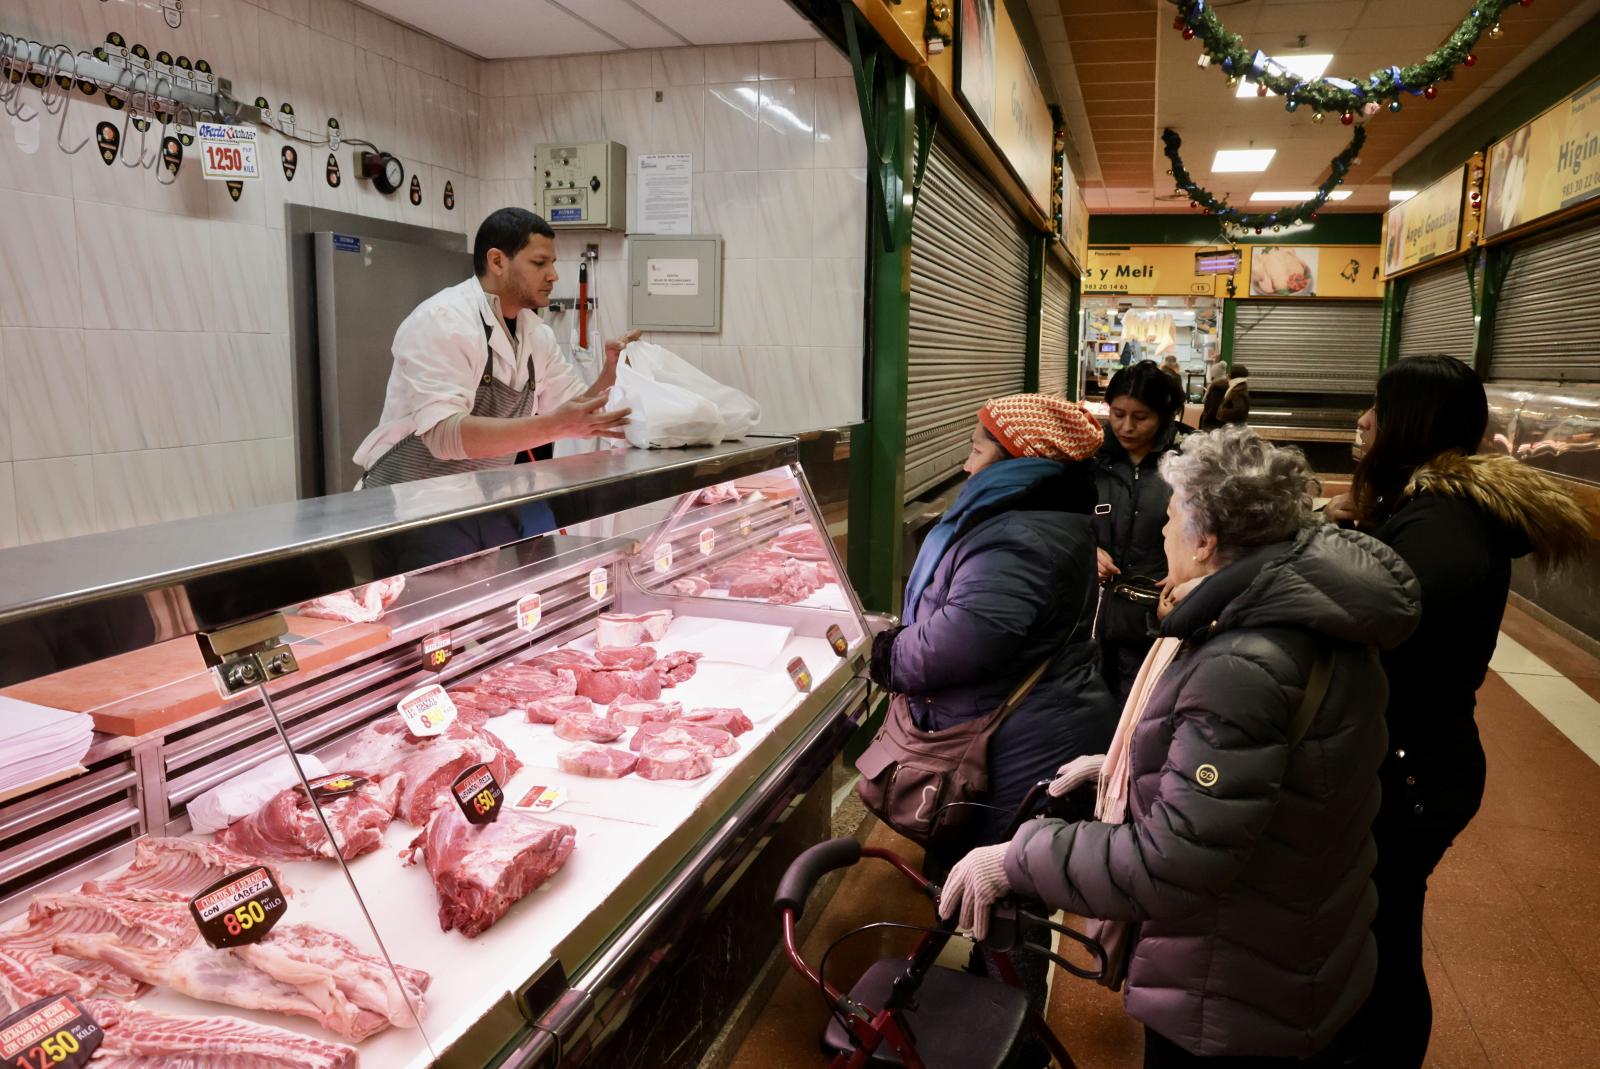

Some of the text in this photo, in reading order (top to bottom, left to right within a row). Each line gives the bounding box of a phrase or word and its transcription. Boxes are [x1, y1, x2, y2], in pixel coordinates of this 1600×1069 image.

[206, 146, 242, 171] 1250
[1557, 131, 1600, 175] Higin
[1100, 269, 1109, 281] y
[1115, 264, 1154, 278] Meli
[474, 789, 495, 816] 650
[203, 880, 269, 918] CON CABEZA
[223, 900, 265, 936] 850
[16, 1030, 80, 1069] 1250
